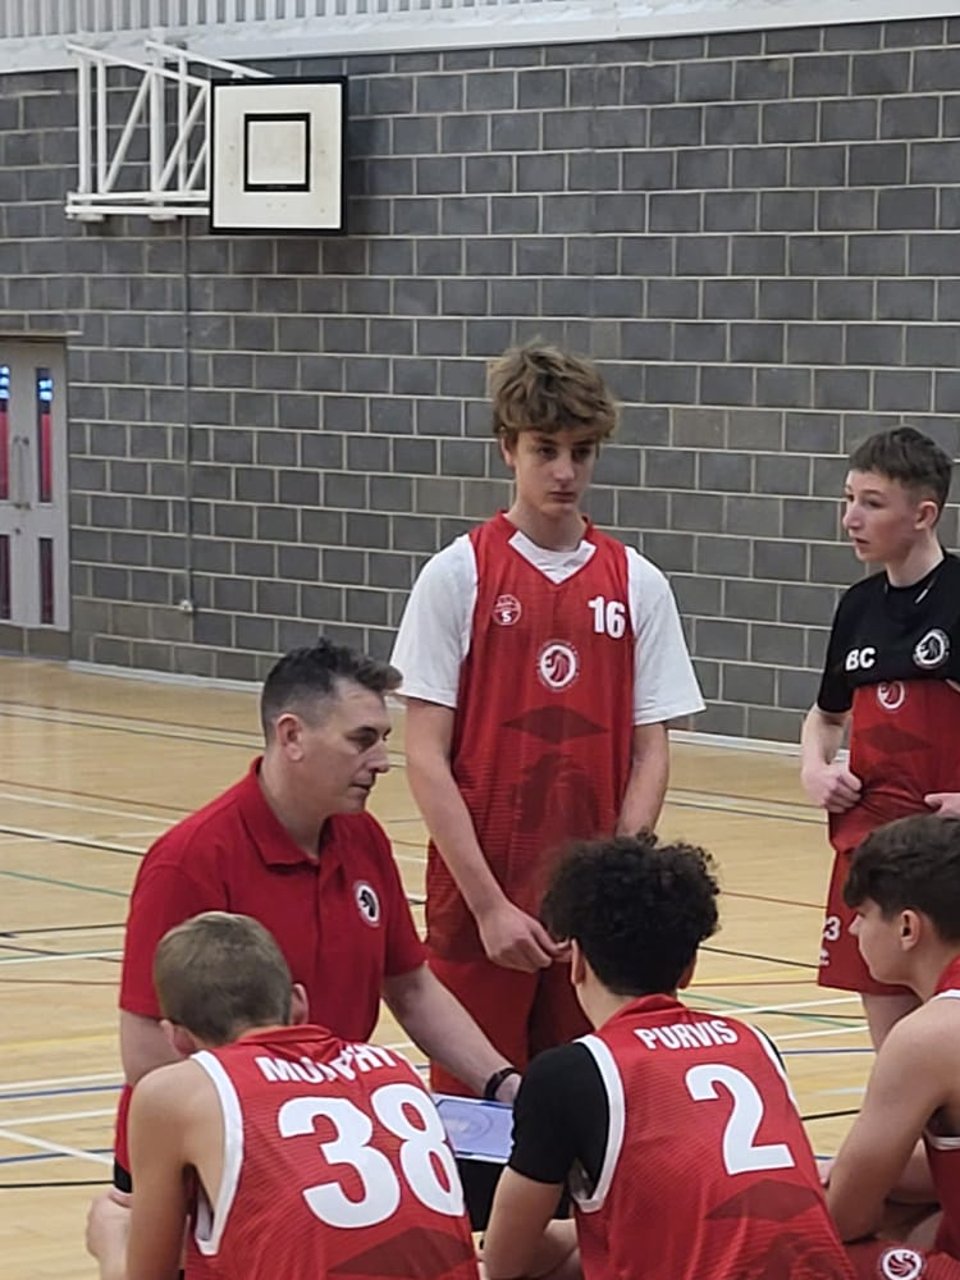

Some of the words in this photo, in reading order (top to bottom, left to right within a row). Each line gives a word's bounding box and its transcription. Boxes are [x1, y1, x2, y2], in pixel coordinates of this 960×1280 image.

[588, 595, 626, 639] 16
[845, 647, 876, 671] BC
[633, 1019, 739, 1049] PURVIS
[685, 1063, 795, 1176] 2
[277, 1082, 466, 1229] 38
